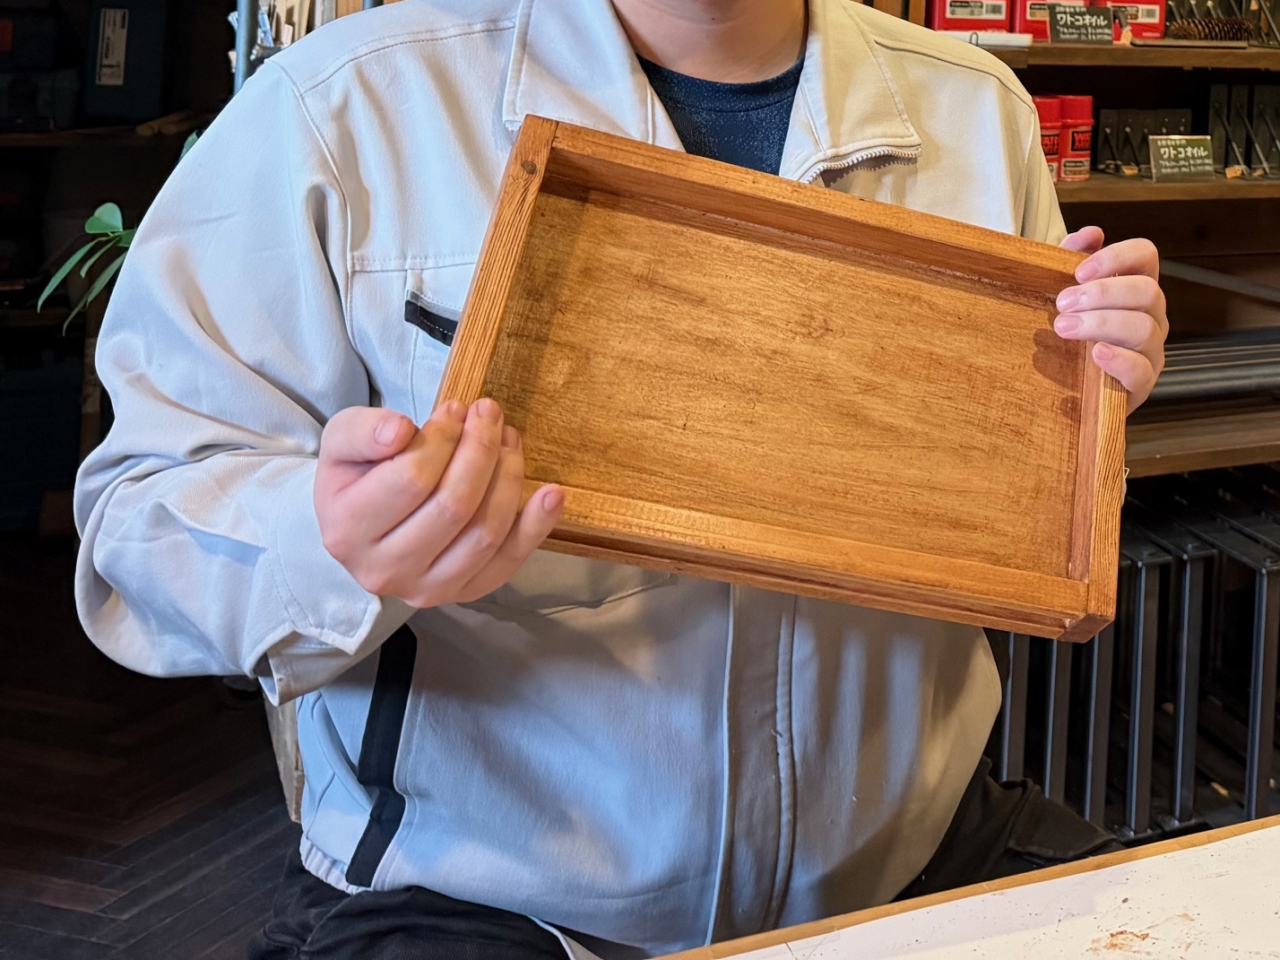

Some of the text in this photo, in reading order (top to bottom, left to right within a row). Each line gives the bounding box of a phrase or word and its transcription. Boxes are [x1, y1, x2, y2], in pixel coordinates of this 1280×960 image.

[1056, 13, 1108, 27] ワトコオイル
[1160, 146, 1209, 159] ワトコオイル
